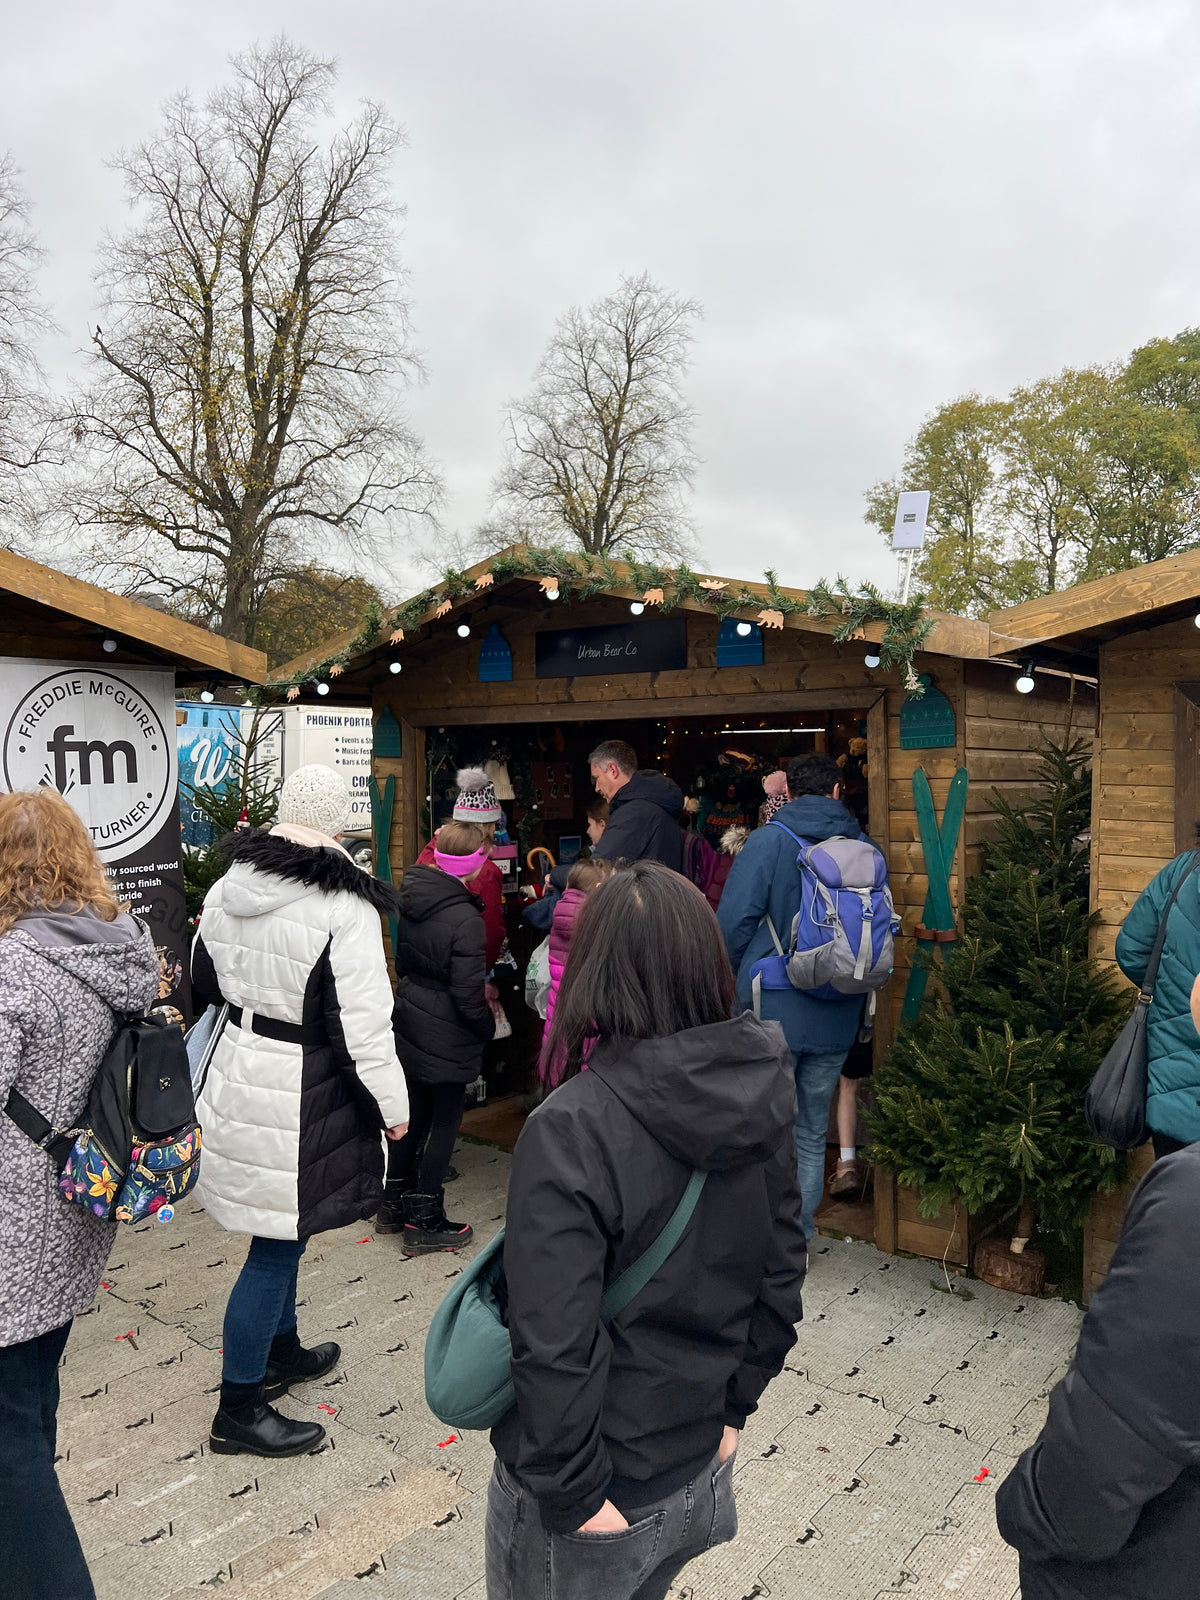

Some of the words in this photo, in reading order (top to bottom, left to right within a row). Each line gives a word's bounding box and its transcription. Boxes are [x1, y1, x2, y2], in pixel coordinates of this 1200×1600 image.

[577, 644, 601, 659] Urban
[603, 643, 623, 657] Bear
[625, 640, 638, 656] Co
[18, 680, 83, 738] FREDDIE
[89, 680, 156, 739] McGUIRE
[306, 714, 342, 726] PHOENIX
[341, 736, 360, 744] Events
[341, 747, 359, 755] Music
[46, 725, 138, 796] fm
[342, 758, 355, 766] Bars
[89, 800, 151, 840] TURNER
[119, 863, 155, 875] sourced
[156, 860, 179, 871] wood
[125, 881, 136, 889] to
[137, 877, 162, 888] finish
[119, 890, 143, 902] pride
